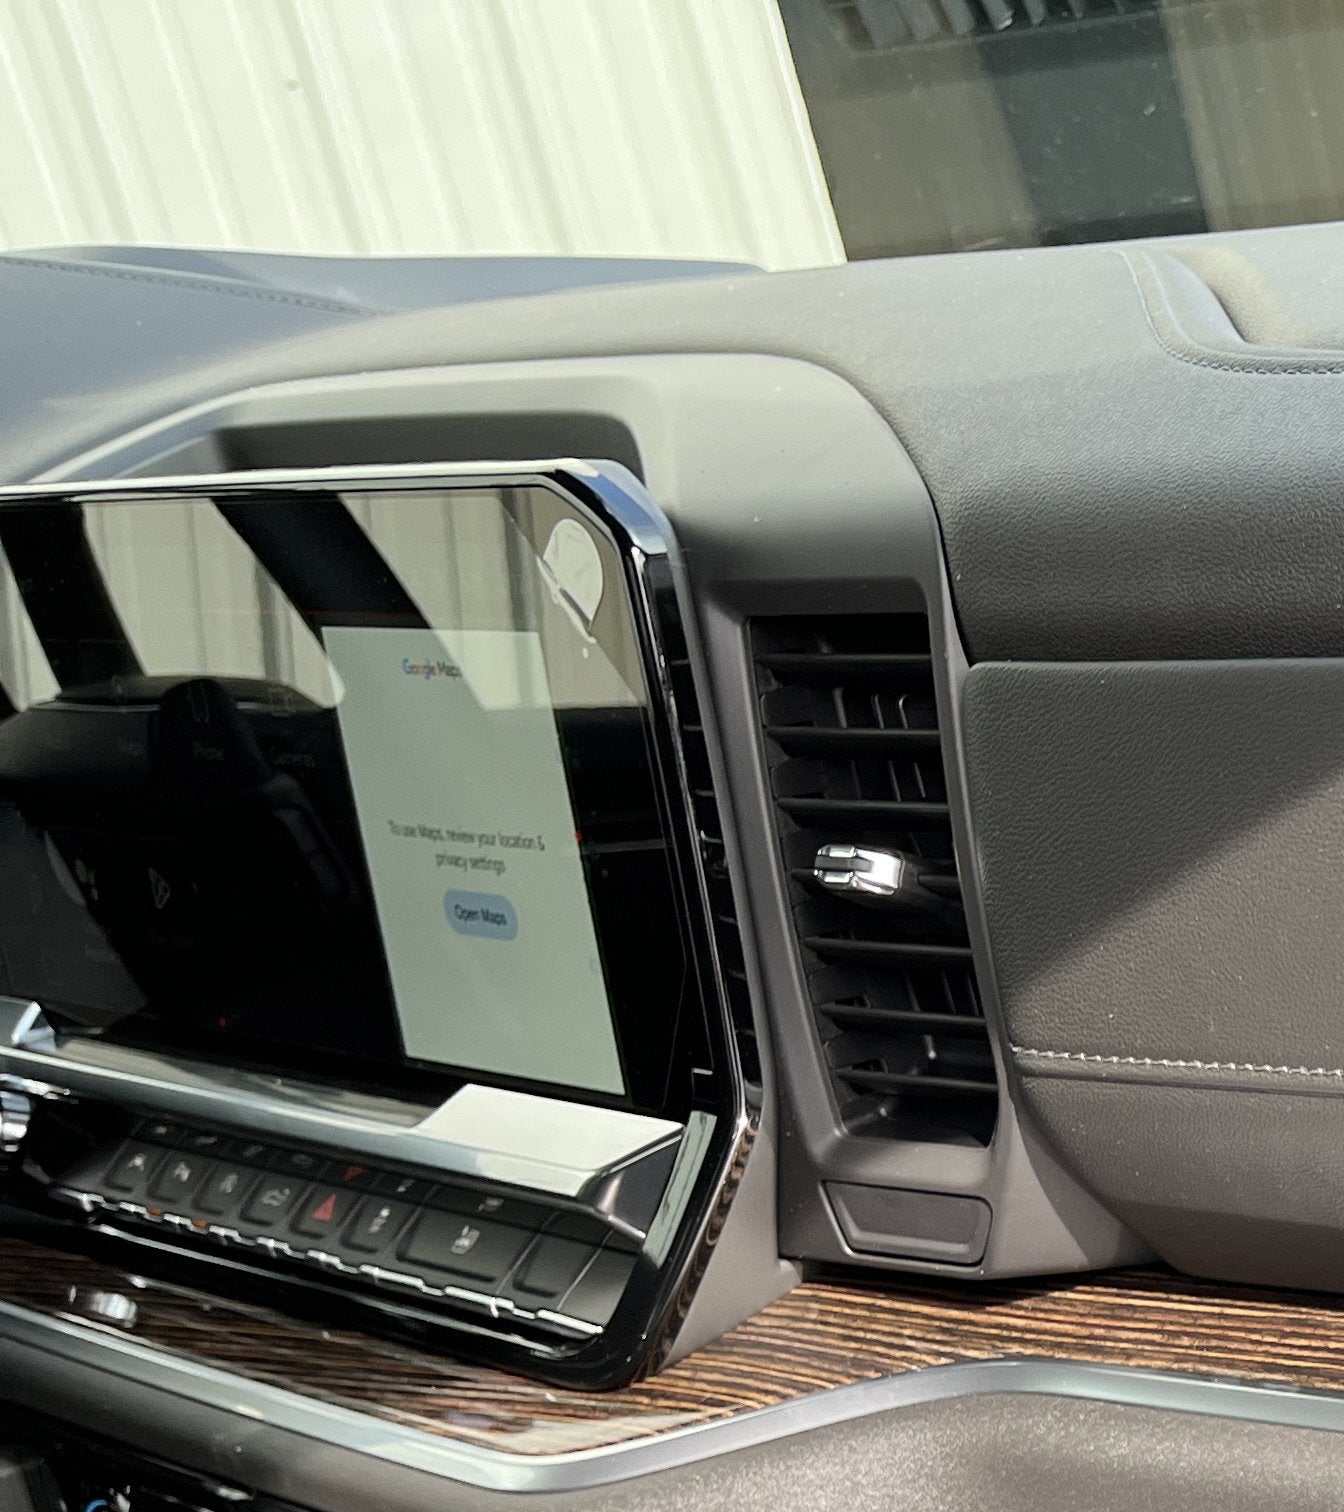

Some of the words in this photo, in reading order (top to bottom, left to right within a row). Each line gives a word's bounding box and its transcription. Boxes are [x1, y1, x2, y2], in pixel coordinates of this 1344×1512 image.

[402, 658, 437, 680] Google
[437, 660, 463, 681] Maps
[454, 904, 481, 922] Open
[481, 908, 507, 927] Maps
